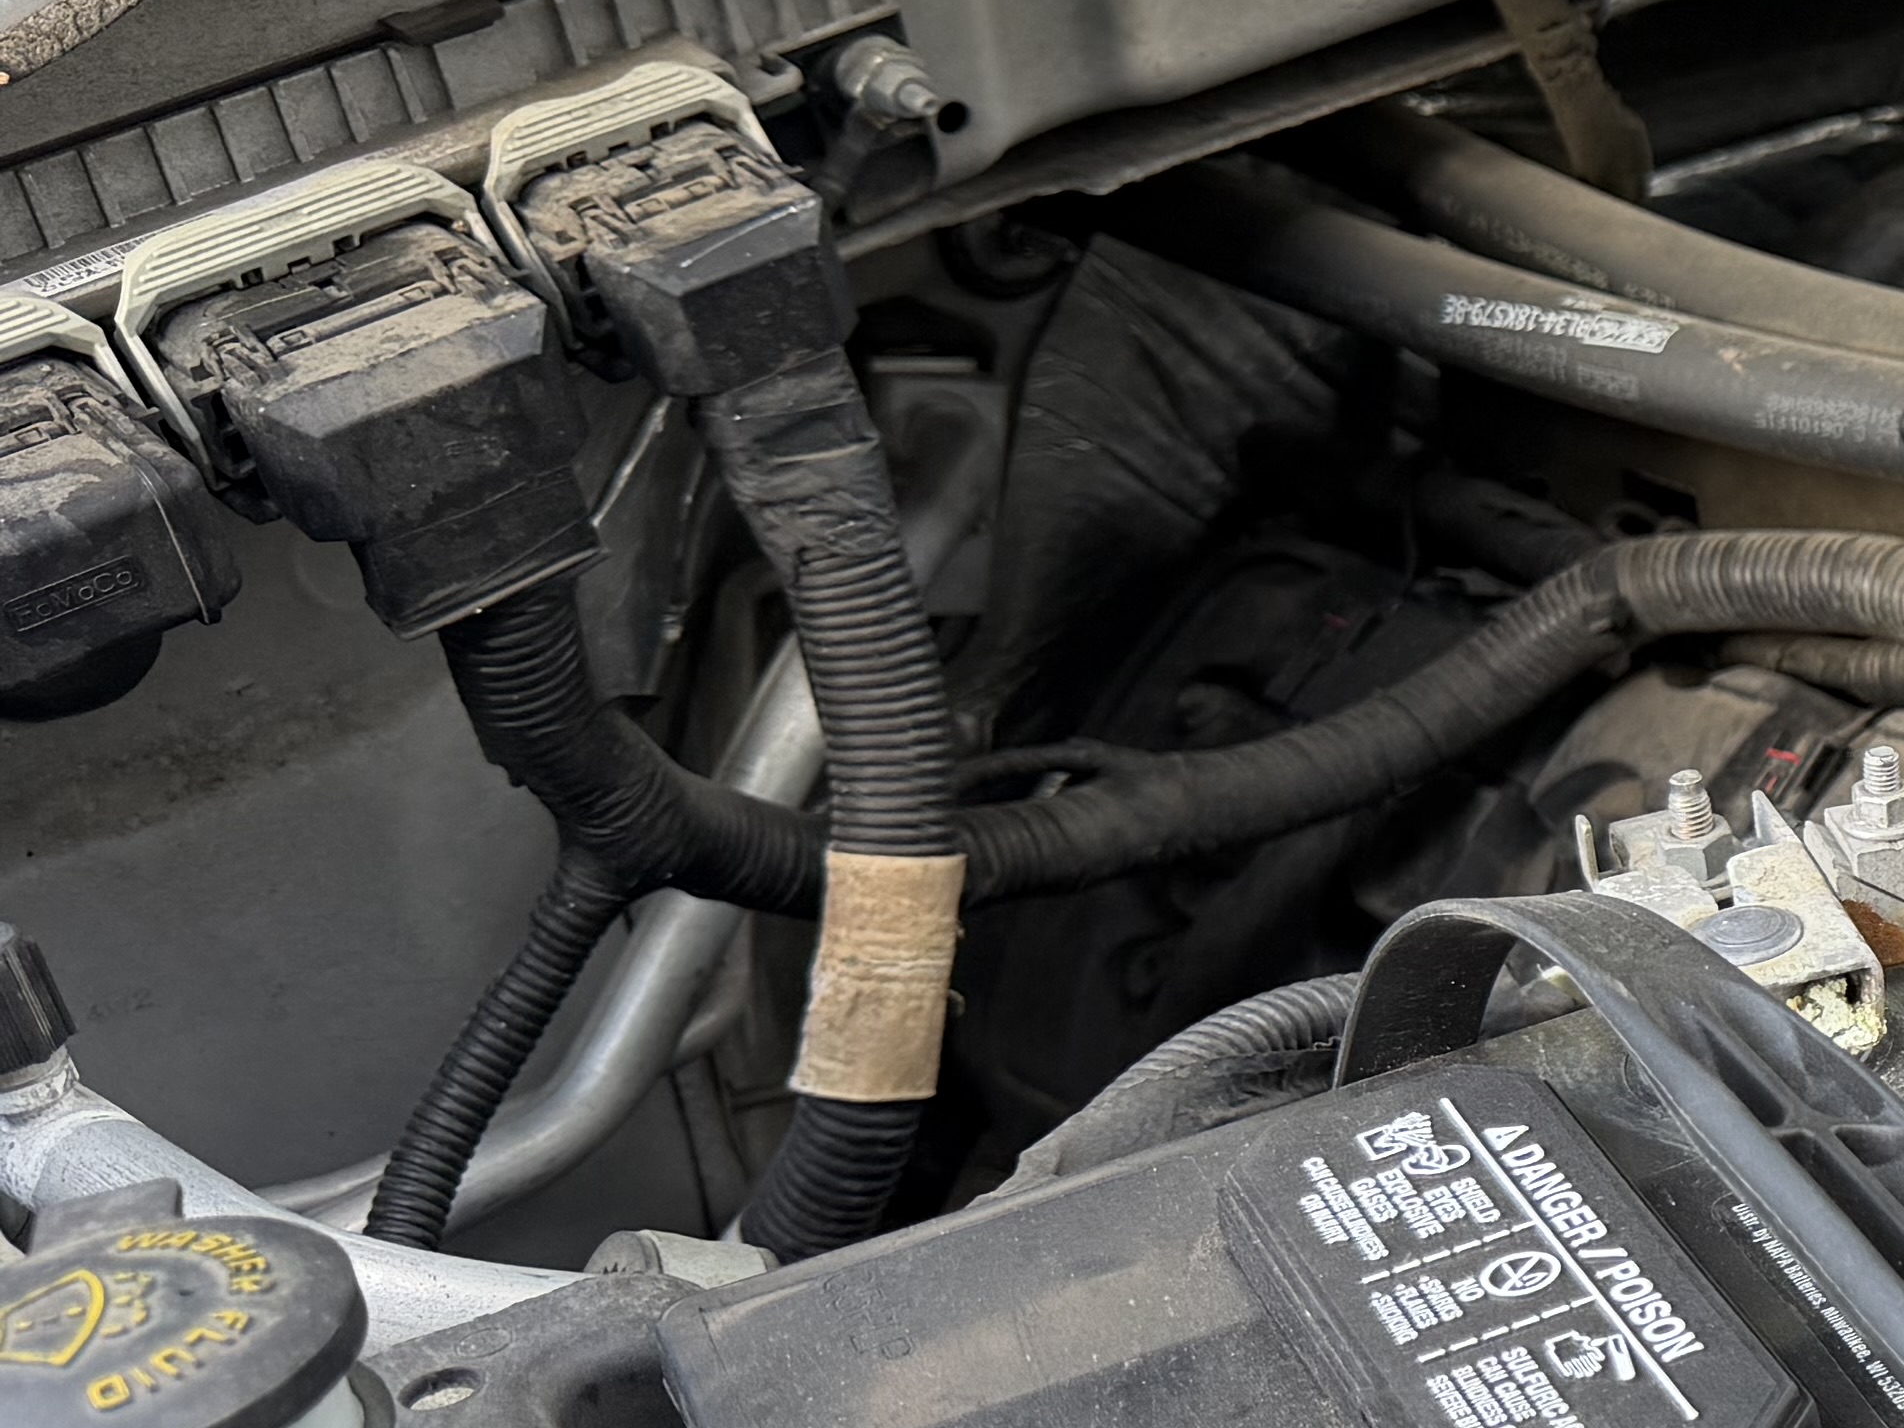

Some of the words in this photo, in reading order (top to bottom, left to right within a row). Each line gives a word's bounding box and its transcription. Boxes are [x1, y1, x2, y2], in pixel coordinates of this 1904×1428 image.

[1350, 1178, 1400, 1224] GASES
[1372, 1166, 1446, 1240] EXPLOSIVE
[1423, 1186, 1468, 1224] EYES
[1450, 1177, 1502, 1225] SHIELD
[1501, 1144, 1609, 1249] DANGER
[1596, 1260, 1706, 1364] POISON
[1748, 1227, 1773, 1245] by
[1760, 1239, 1794, 1267] NAPA
[117, 1229, 279, 1295] WASHER
[1451, 1276, 1486, 1304] NO
[86, 1308, 253, 1410] FLUID
[1864, 1360, 1889, 1379] WI
[1426, 1375, 1474, 1422] SEVERE
[1451, 1365, 1509, 1428] BLINDNESS
[1477, 1356, 1510, 1384] CAN
[1494, 1382, 1538, 1424] CAUSE
[1501, 1347, 1571, 1420] SULFURIC
